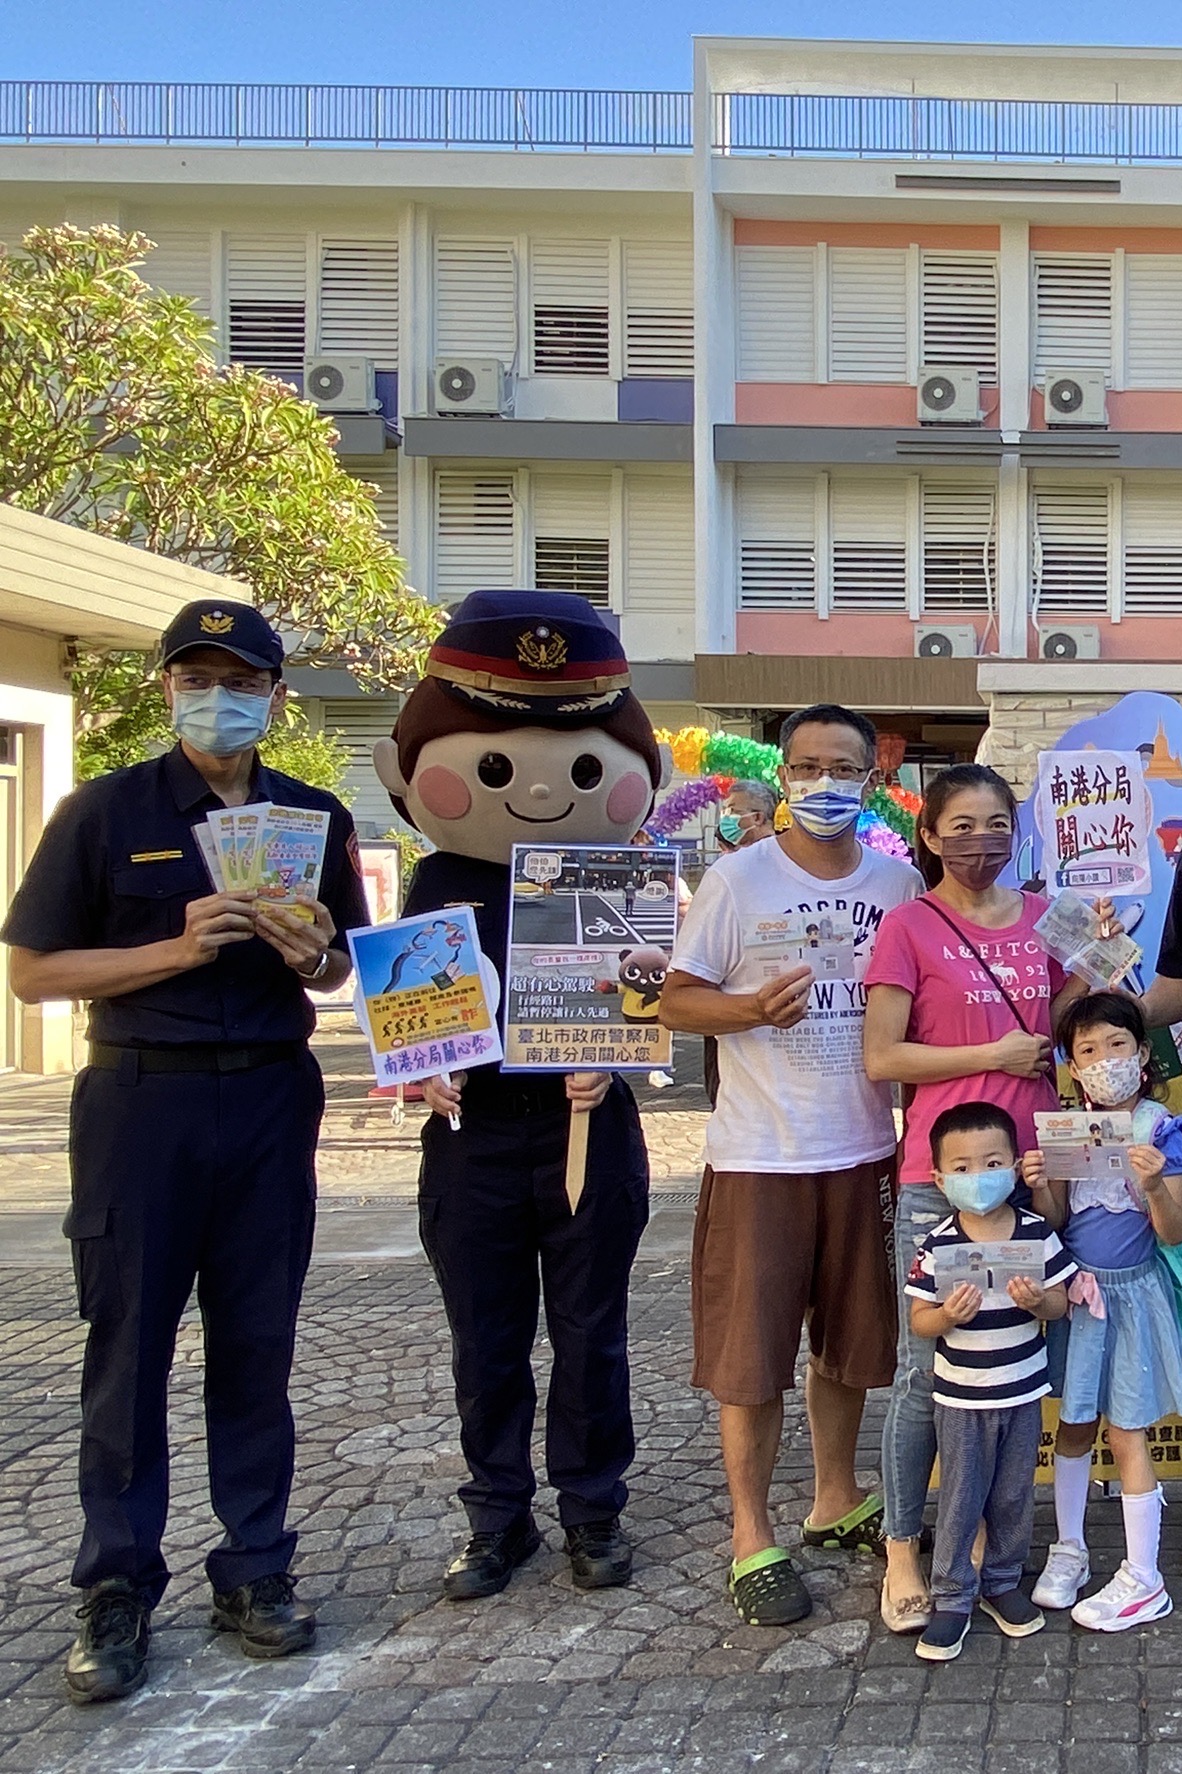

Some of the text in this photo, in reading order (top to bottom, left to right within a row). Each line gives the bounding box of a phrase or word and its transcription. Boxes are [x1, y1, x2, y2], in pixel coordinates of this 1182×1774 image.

[1050, 765, 1132, 807] 南港分局
[1055, 813, 1137, 860] 關心你
[1025, 965, 1046, 977] 92
[511, 976, 597, 993] 超有心駕駛
[964, 990, 1002, 1005] NEW
[518, 1028, 660, 1044] 臺北市政府警察局
[385, 1034, 487, 1075] 南港分局關心你
[526, 1047, 650, 1063] 南港分局關心您
